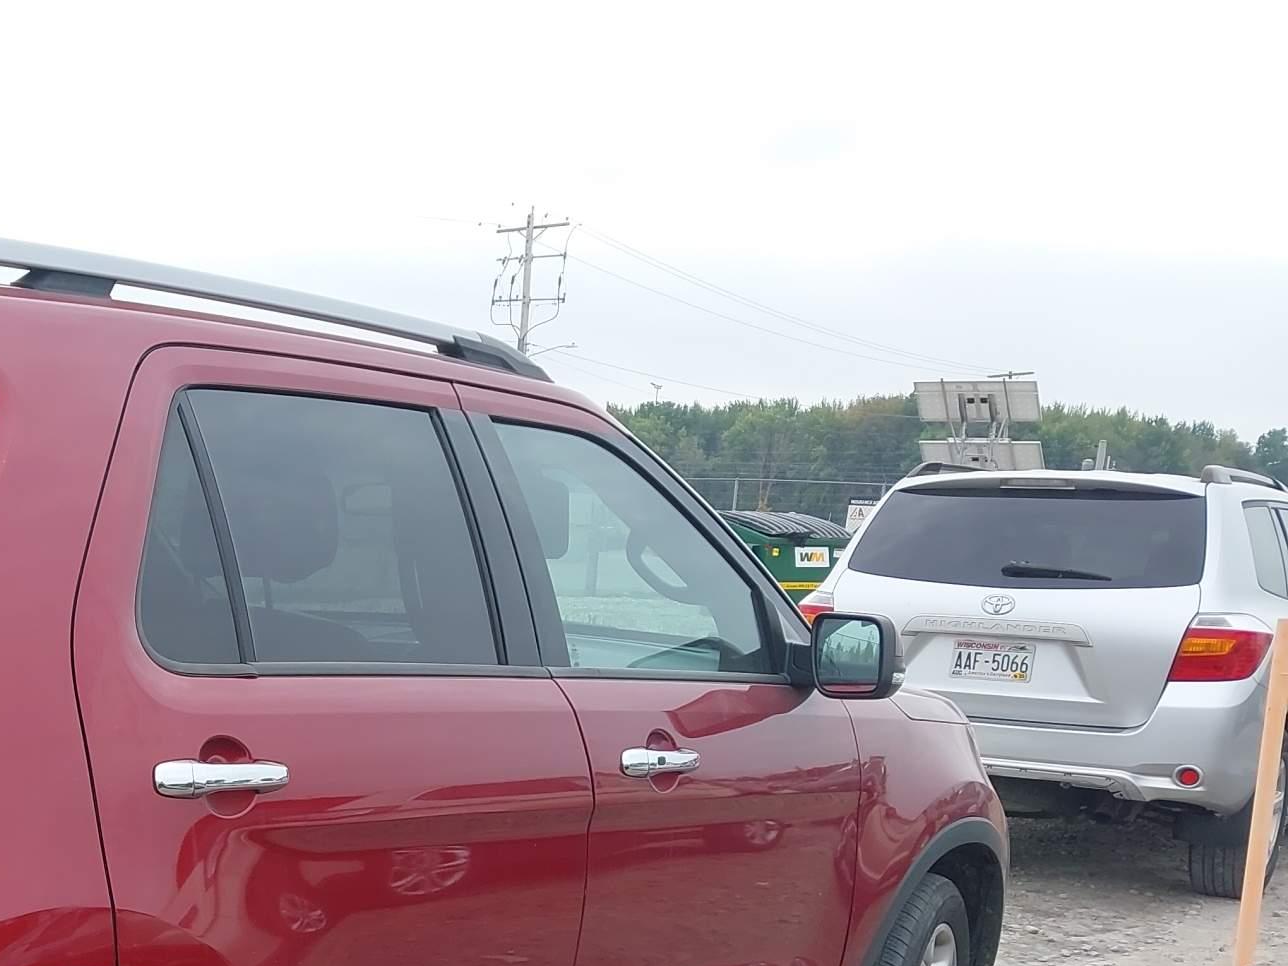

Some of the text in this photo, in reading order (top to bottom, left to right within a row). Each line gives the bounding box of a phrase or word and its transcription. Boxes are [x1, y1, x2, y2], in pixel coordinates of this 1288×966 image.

[799, 551, 825, 562] WM
[924, 618, 1067, 635] HIGHLANDER
[956, 641, 1000, 651] WISCONSIN
[953, 651, 1029, 674] AAF-5066
